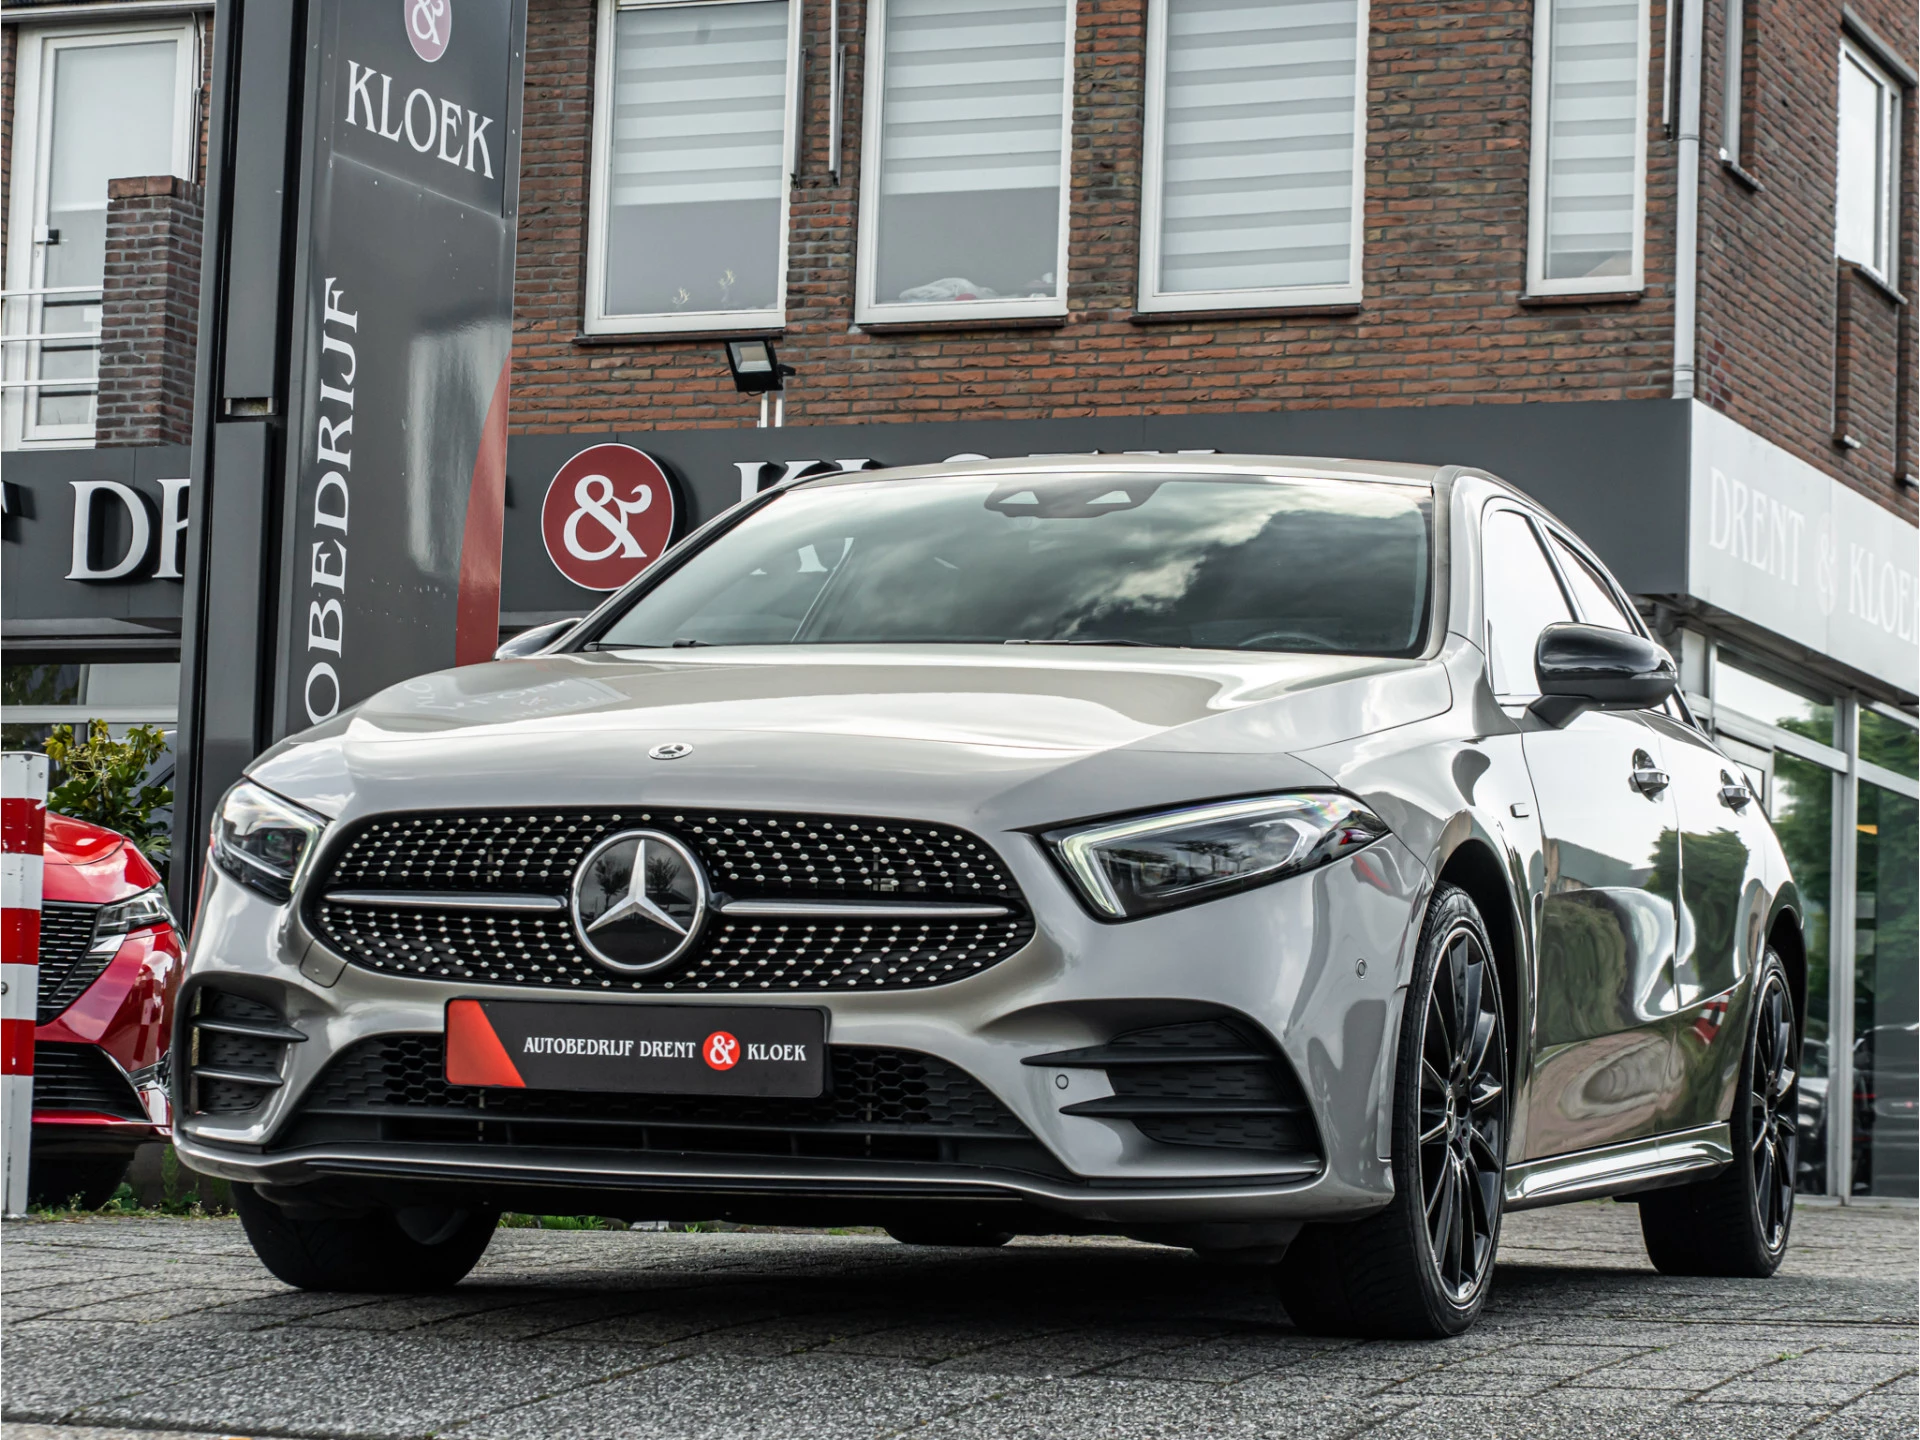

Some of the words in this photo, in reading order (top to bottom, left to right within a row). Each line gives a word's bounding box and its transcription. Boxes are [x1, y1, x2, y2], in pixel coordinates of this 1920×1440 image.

[344, 60, 495, 180] KLOEK
[564, 474, 653, 560] &
[1709, 466, 1805, 587] DRENT
[523, 1036, 635, 1057] AUTOBEDRIJF
[639, 1040, 696, 1059] DRENT
[709, 1034, 736, 1065] &
[747, 1043, 807, 1061] KLOEK
